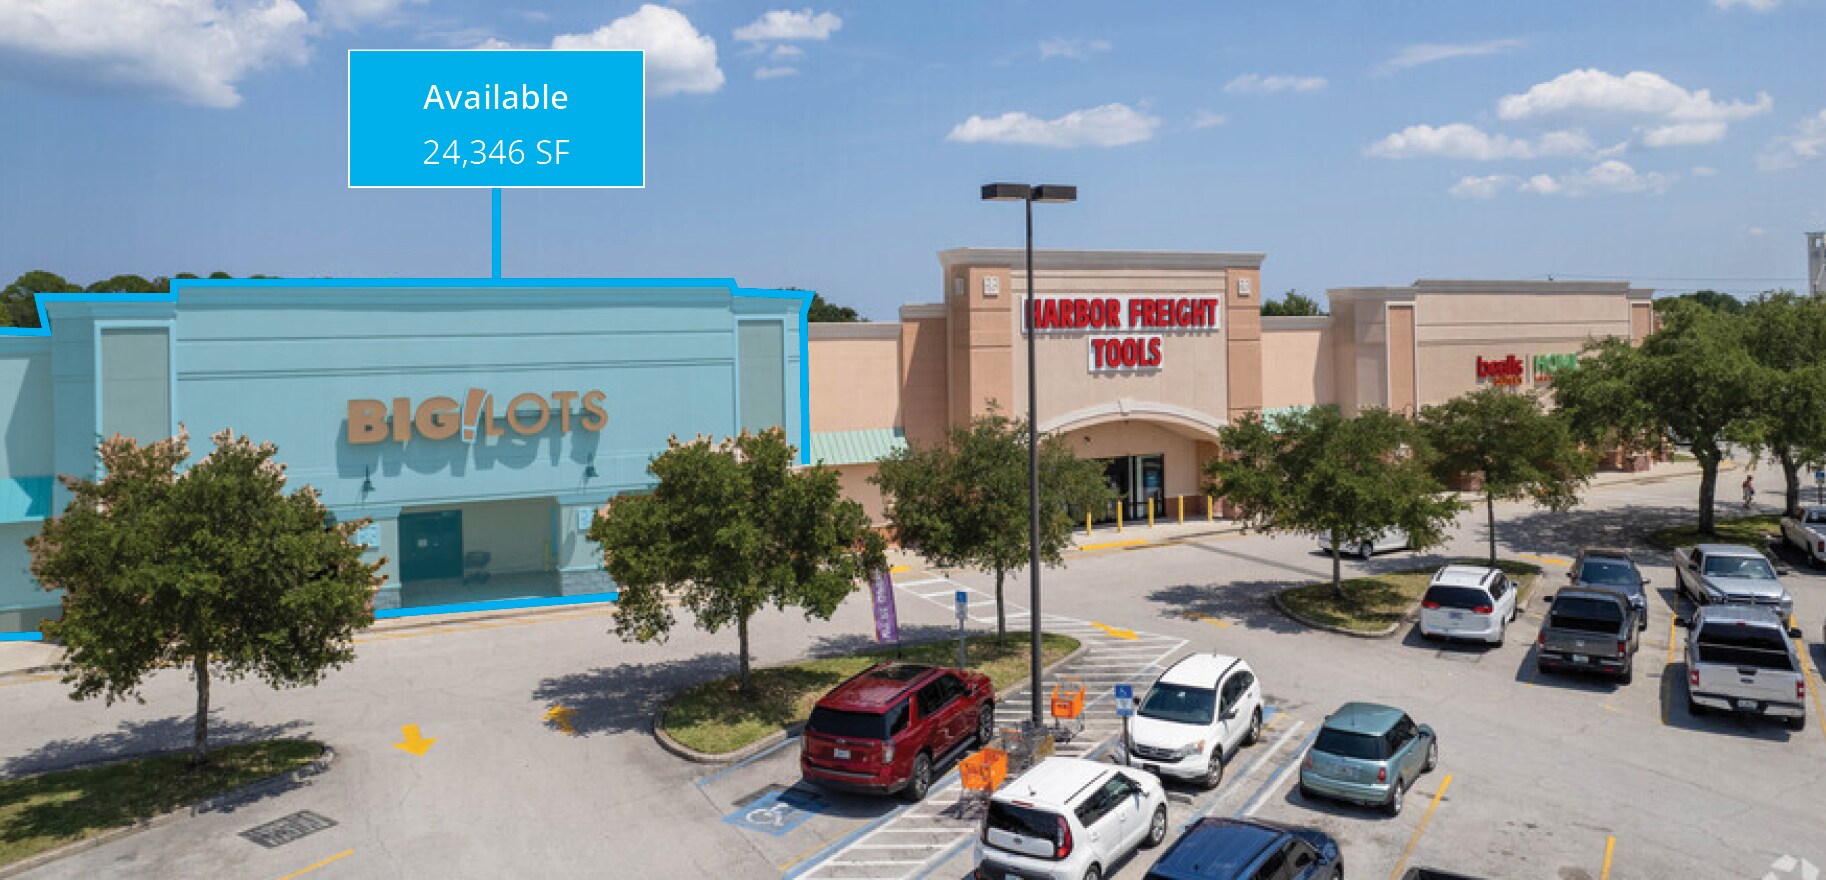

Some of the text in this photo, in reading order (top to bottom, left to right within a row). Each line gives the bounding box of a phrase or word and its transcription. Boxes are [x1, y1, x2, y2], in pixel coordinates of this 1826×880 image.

[1025, 298, 1219, 329] HARBOR FREIGHT
[1091, 336, 1162, 368] TOOLS
[1534, 353, 1579, 371] HOM
